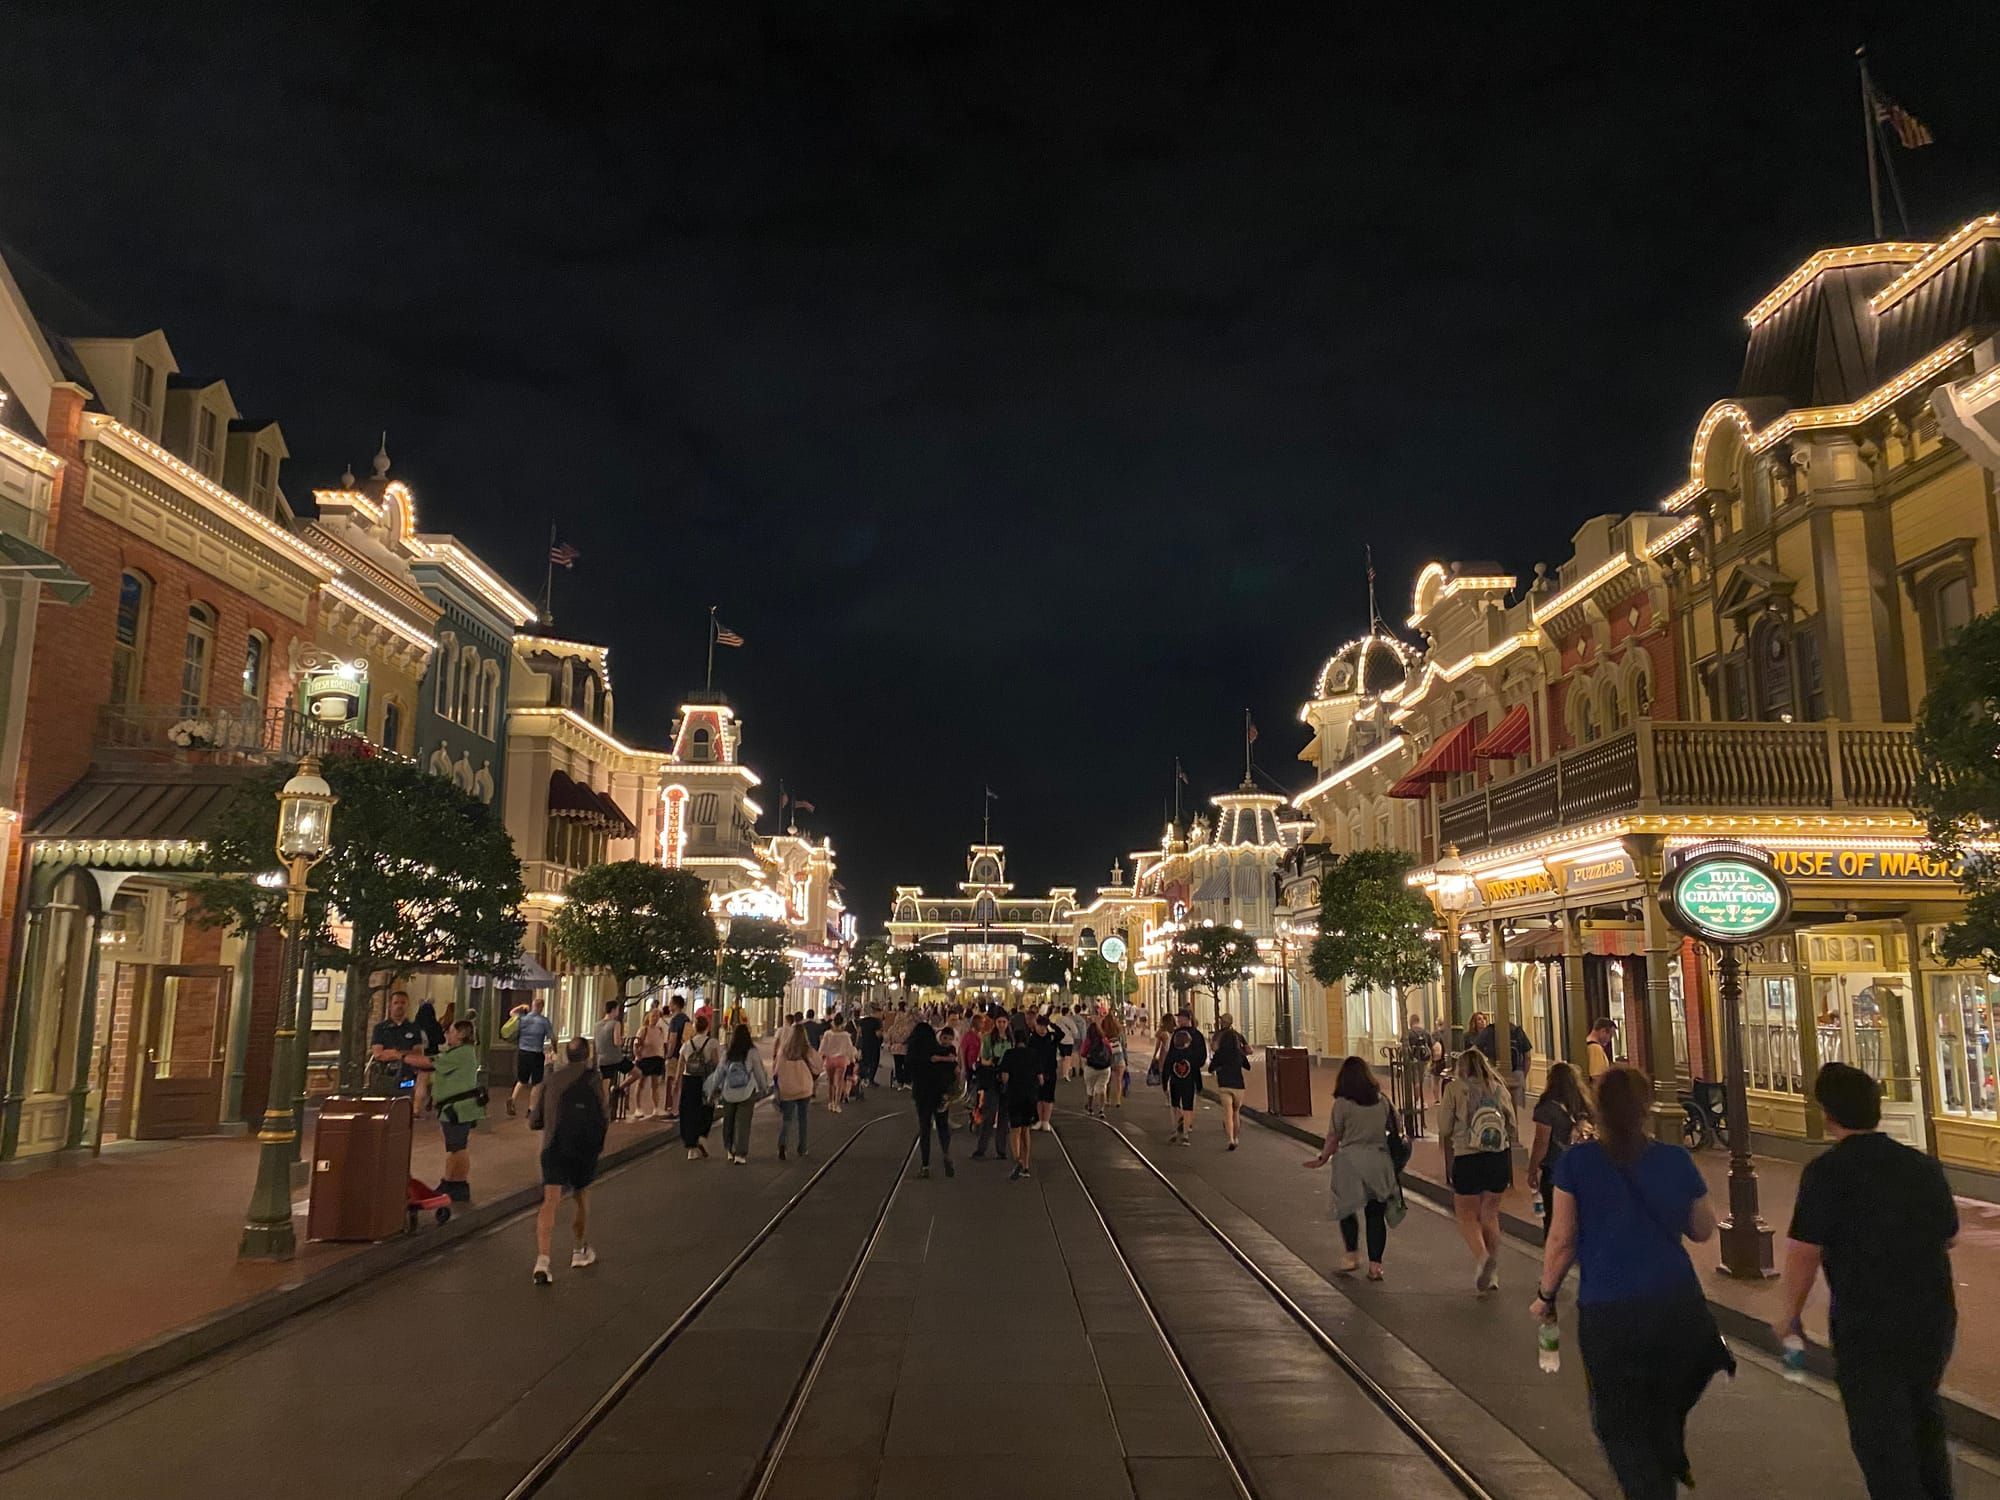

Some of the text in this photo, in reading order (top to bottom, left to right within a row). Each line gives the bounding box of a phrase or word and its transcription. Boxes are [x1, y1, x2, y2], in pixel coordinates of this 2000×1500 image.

[1574, 859, 1624, 883] PUZZLES
[1839, 852, 1875, 877] OF
[1709, 871, 1750, 883] HALL
[1685, 891, 1775, 904] CHAMPIONS
